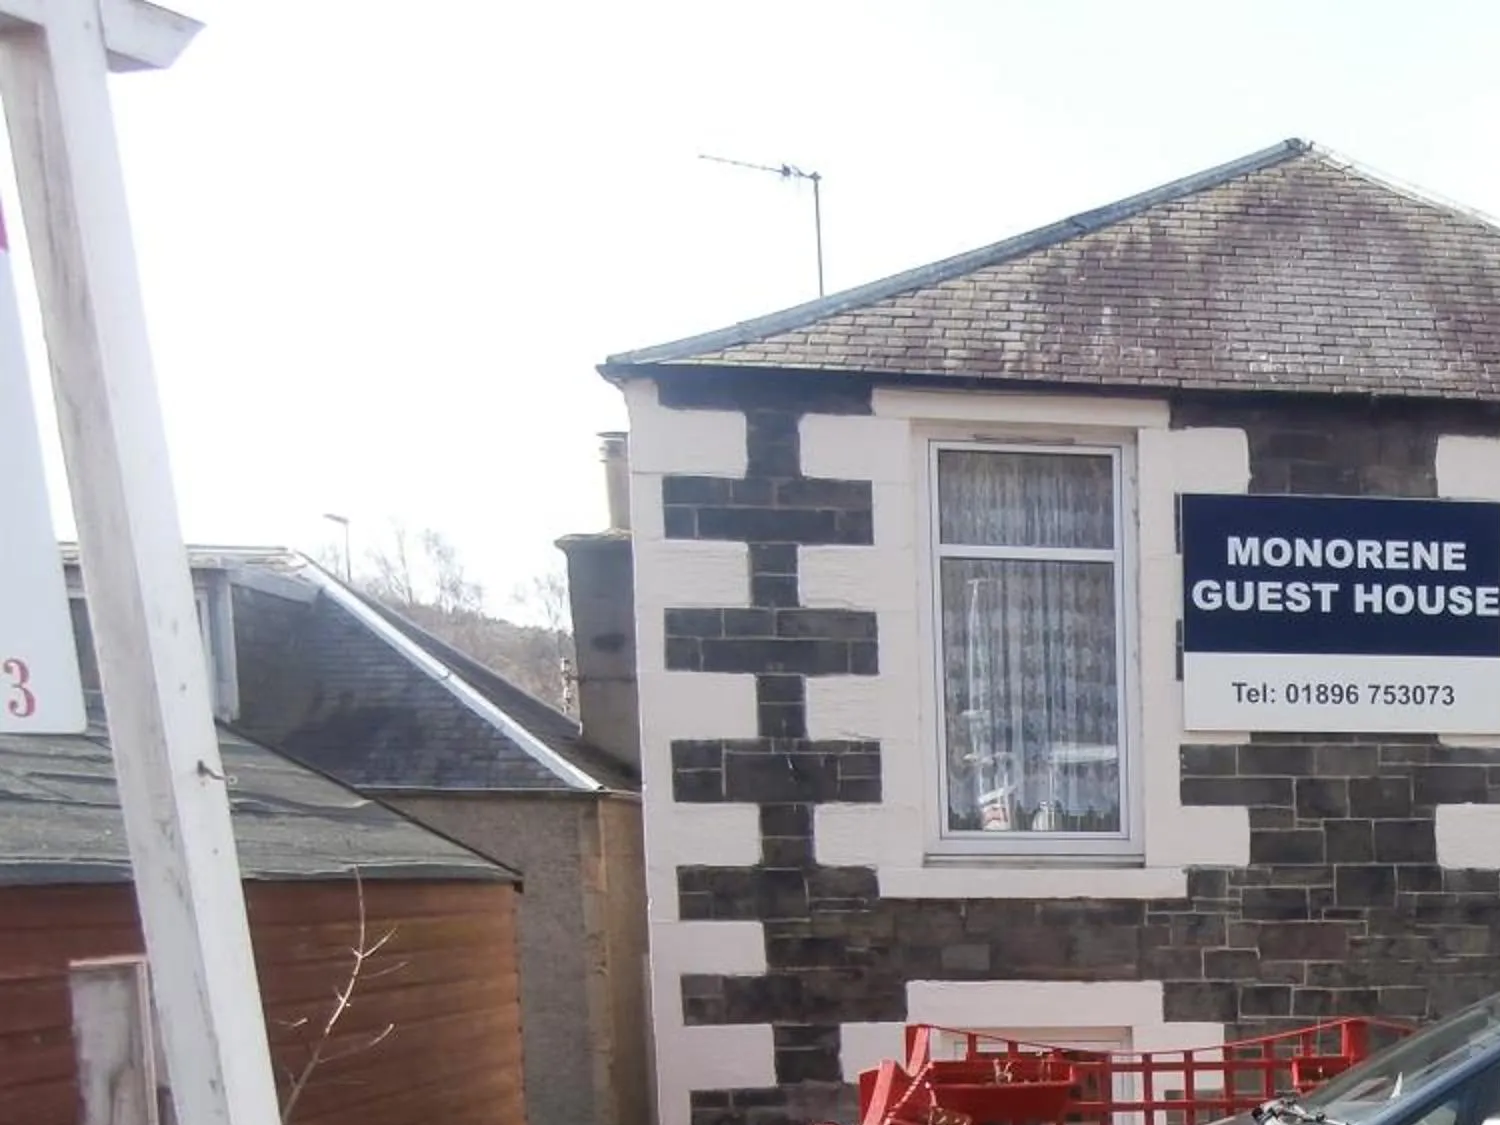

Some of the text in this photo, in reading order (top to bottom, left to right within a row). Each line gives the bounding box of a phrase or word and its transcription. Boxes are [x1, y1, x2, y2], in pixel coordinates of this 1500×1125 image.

[1227, 537, 1467, 571] MONORENE
[1192, 580, 1500, 616] GUEST HOUSE
[3, 659, 35, 718] 3
[1232, 682, 1455, 706] Tel: 01896 753073
